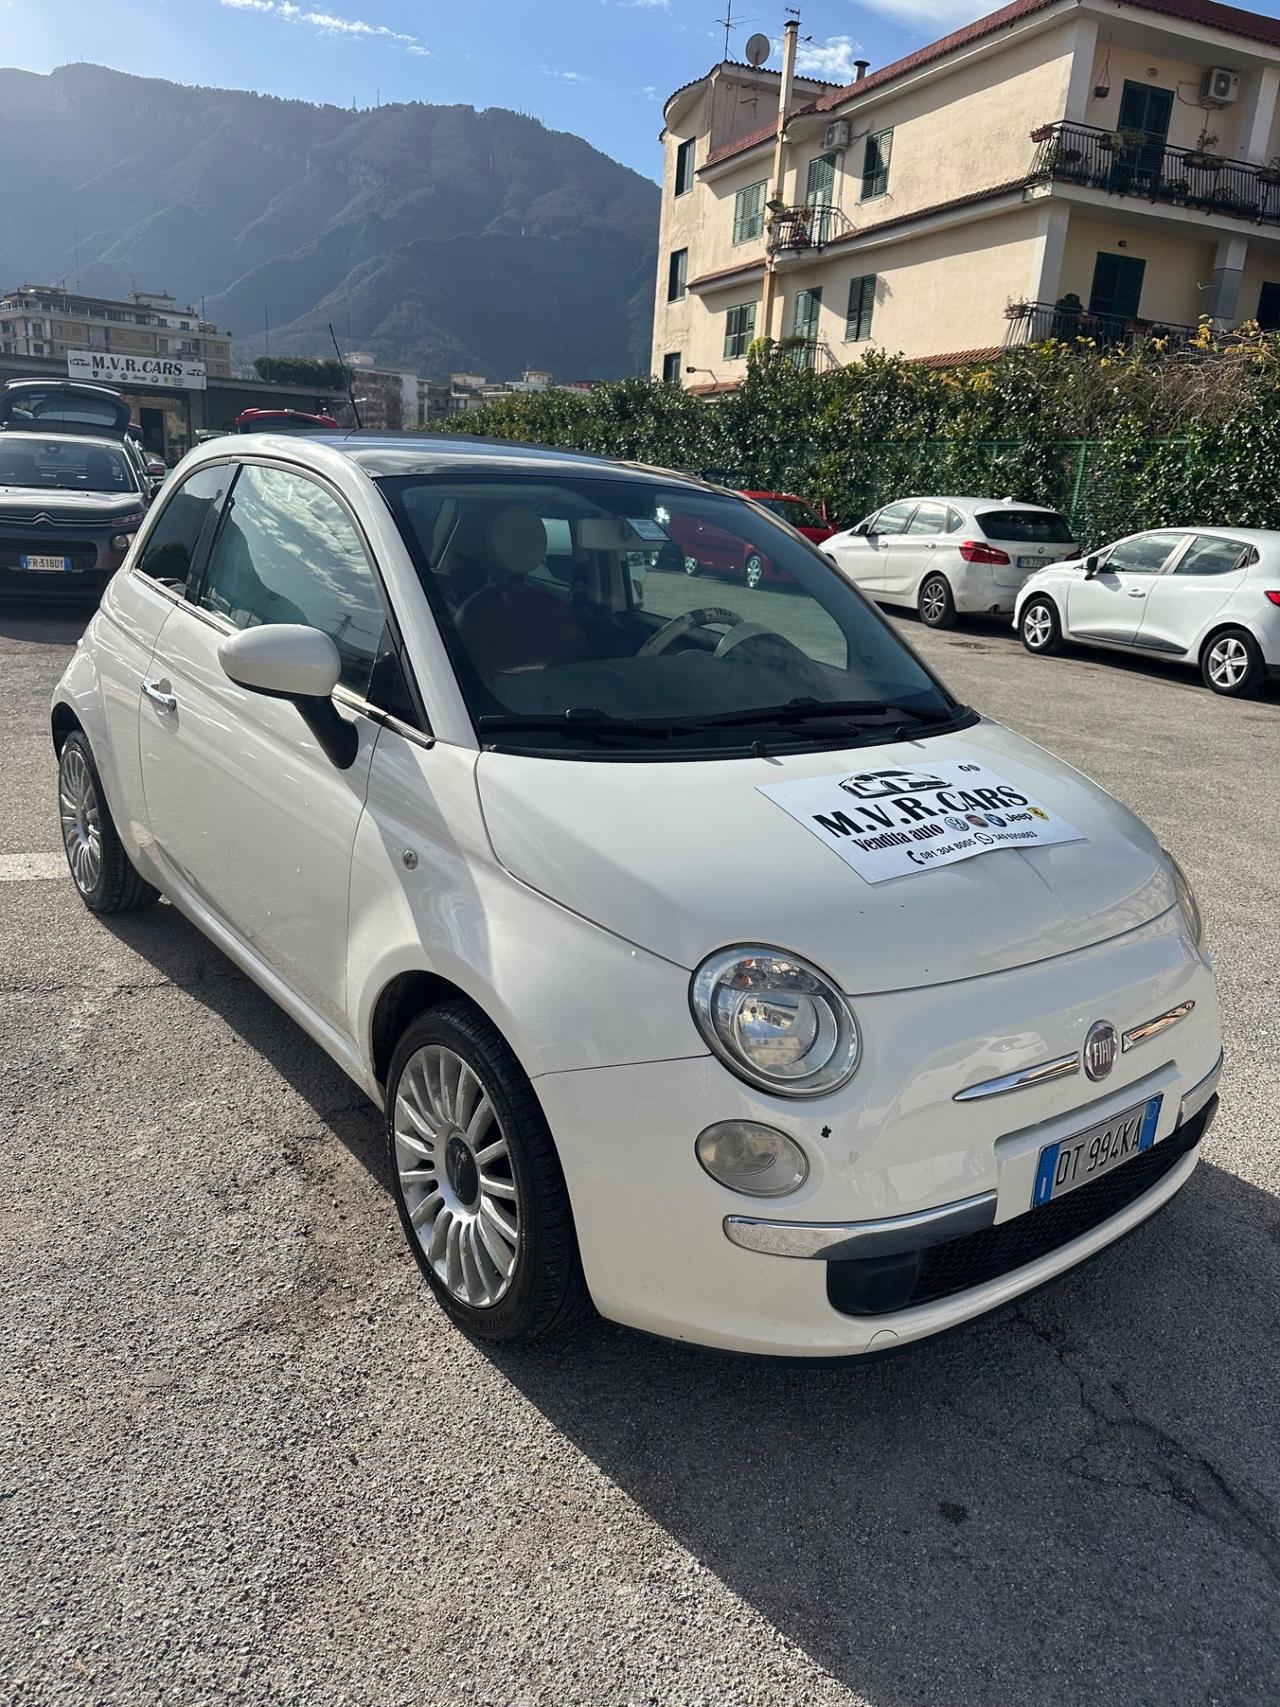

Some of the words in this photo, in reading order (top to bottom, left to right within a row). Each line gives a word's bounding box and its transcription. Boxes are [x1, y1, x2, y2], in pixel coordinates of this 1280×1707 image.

[812, 786, 1029, 838] M.V.R.CARS
[1005, 813, 1033, 822] Jeep
[851, 831, 913, 852] Vendita
[908, 823, 944, 841] auto
[920, 847, 938, 860] 081
[936, 843, 956, 856] 304
[953, 838, 977, 850] 8005
[1093, 1038, 1111, 1067] FIAT
[1055, 1142, 1085, 1186] DT
[1086, 1114, 1142, 1172] 994KA
